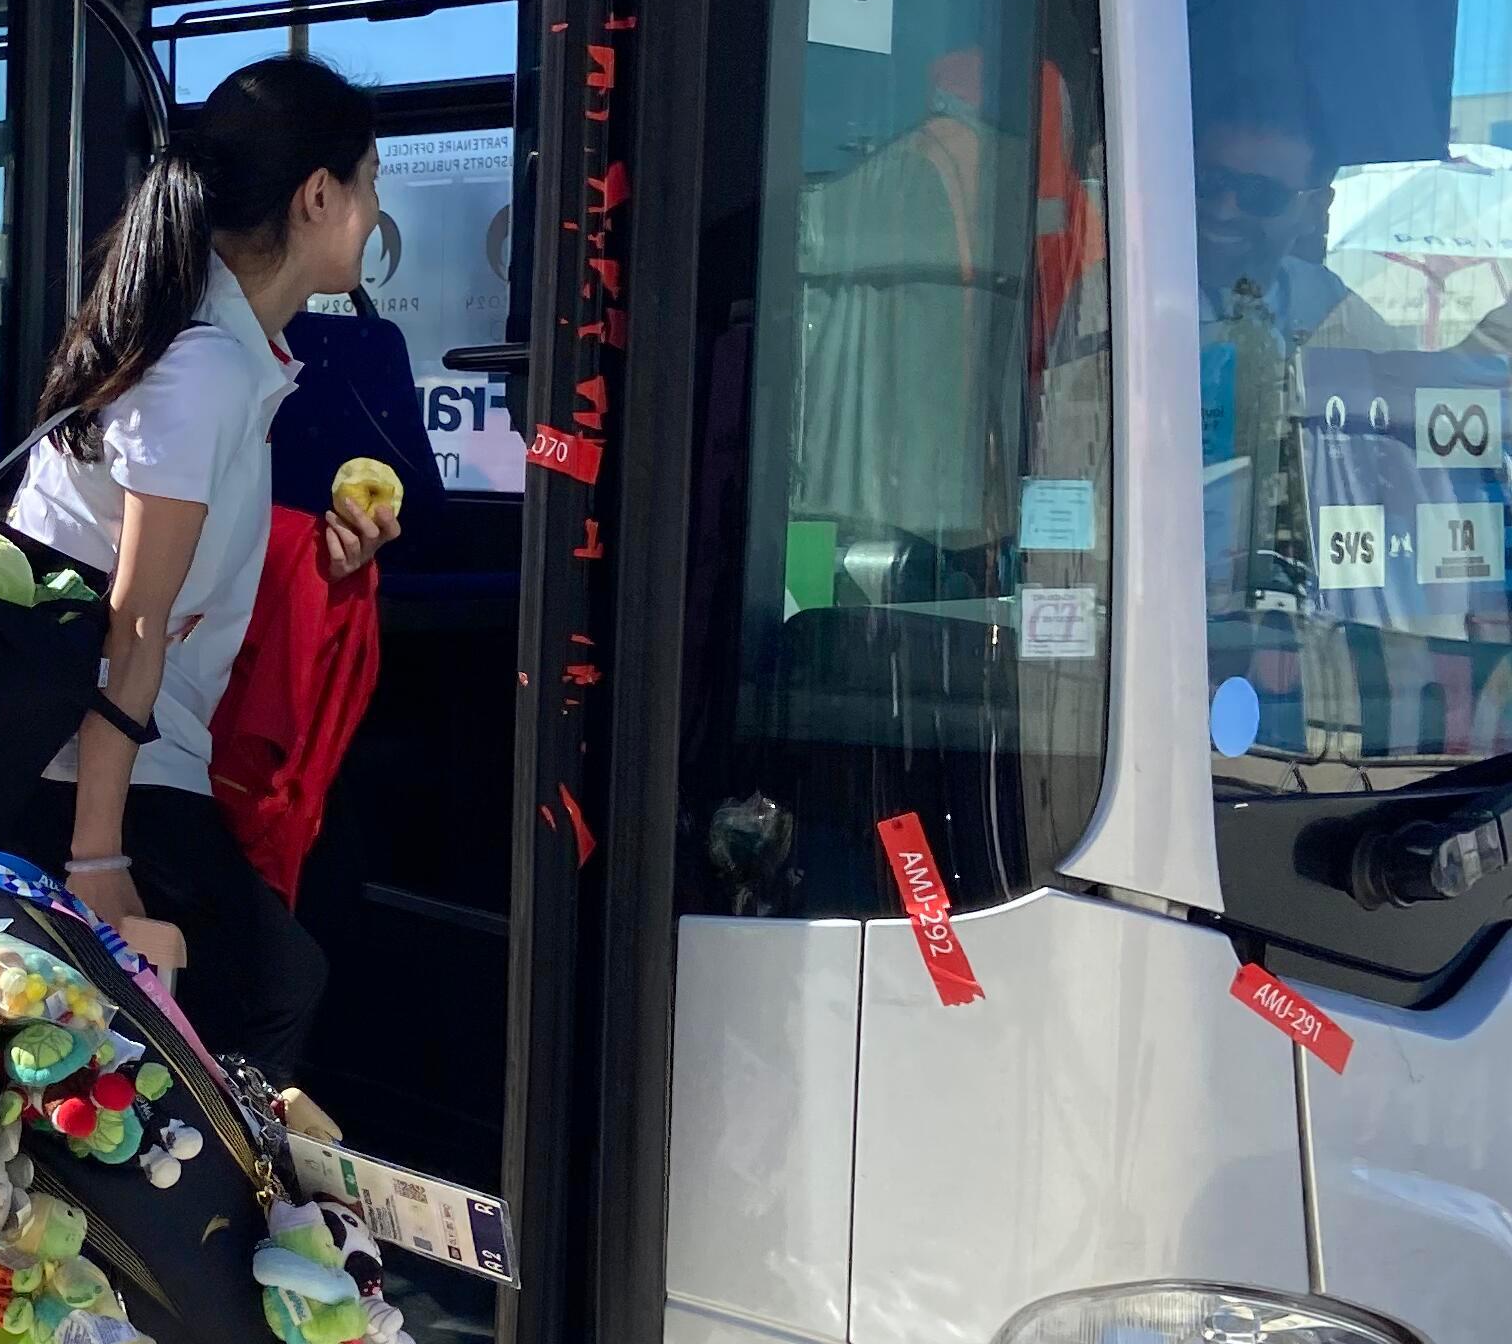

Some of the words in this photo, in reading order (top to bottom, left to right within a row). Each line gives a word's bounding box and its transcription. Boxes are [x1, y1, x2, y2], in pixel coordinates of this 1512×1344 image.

[1330, 531, 1374, 565] SYS
[1448, 519, 1475, 551] TA
[898, 852, 954, 957] AMJ-292
[1253, 983, 1322, 1042] AMJ-291
